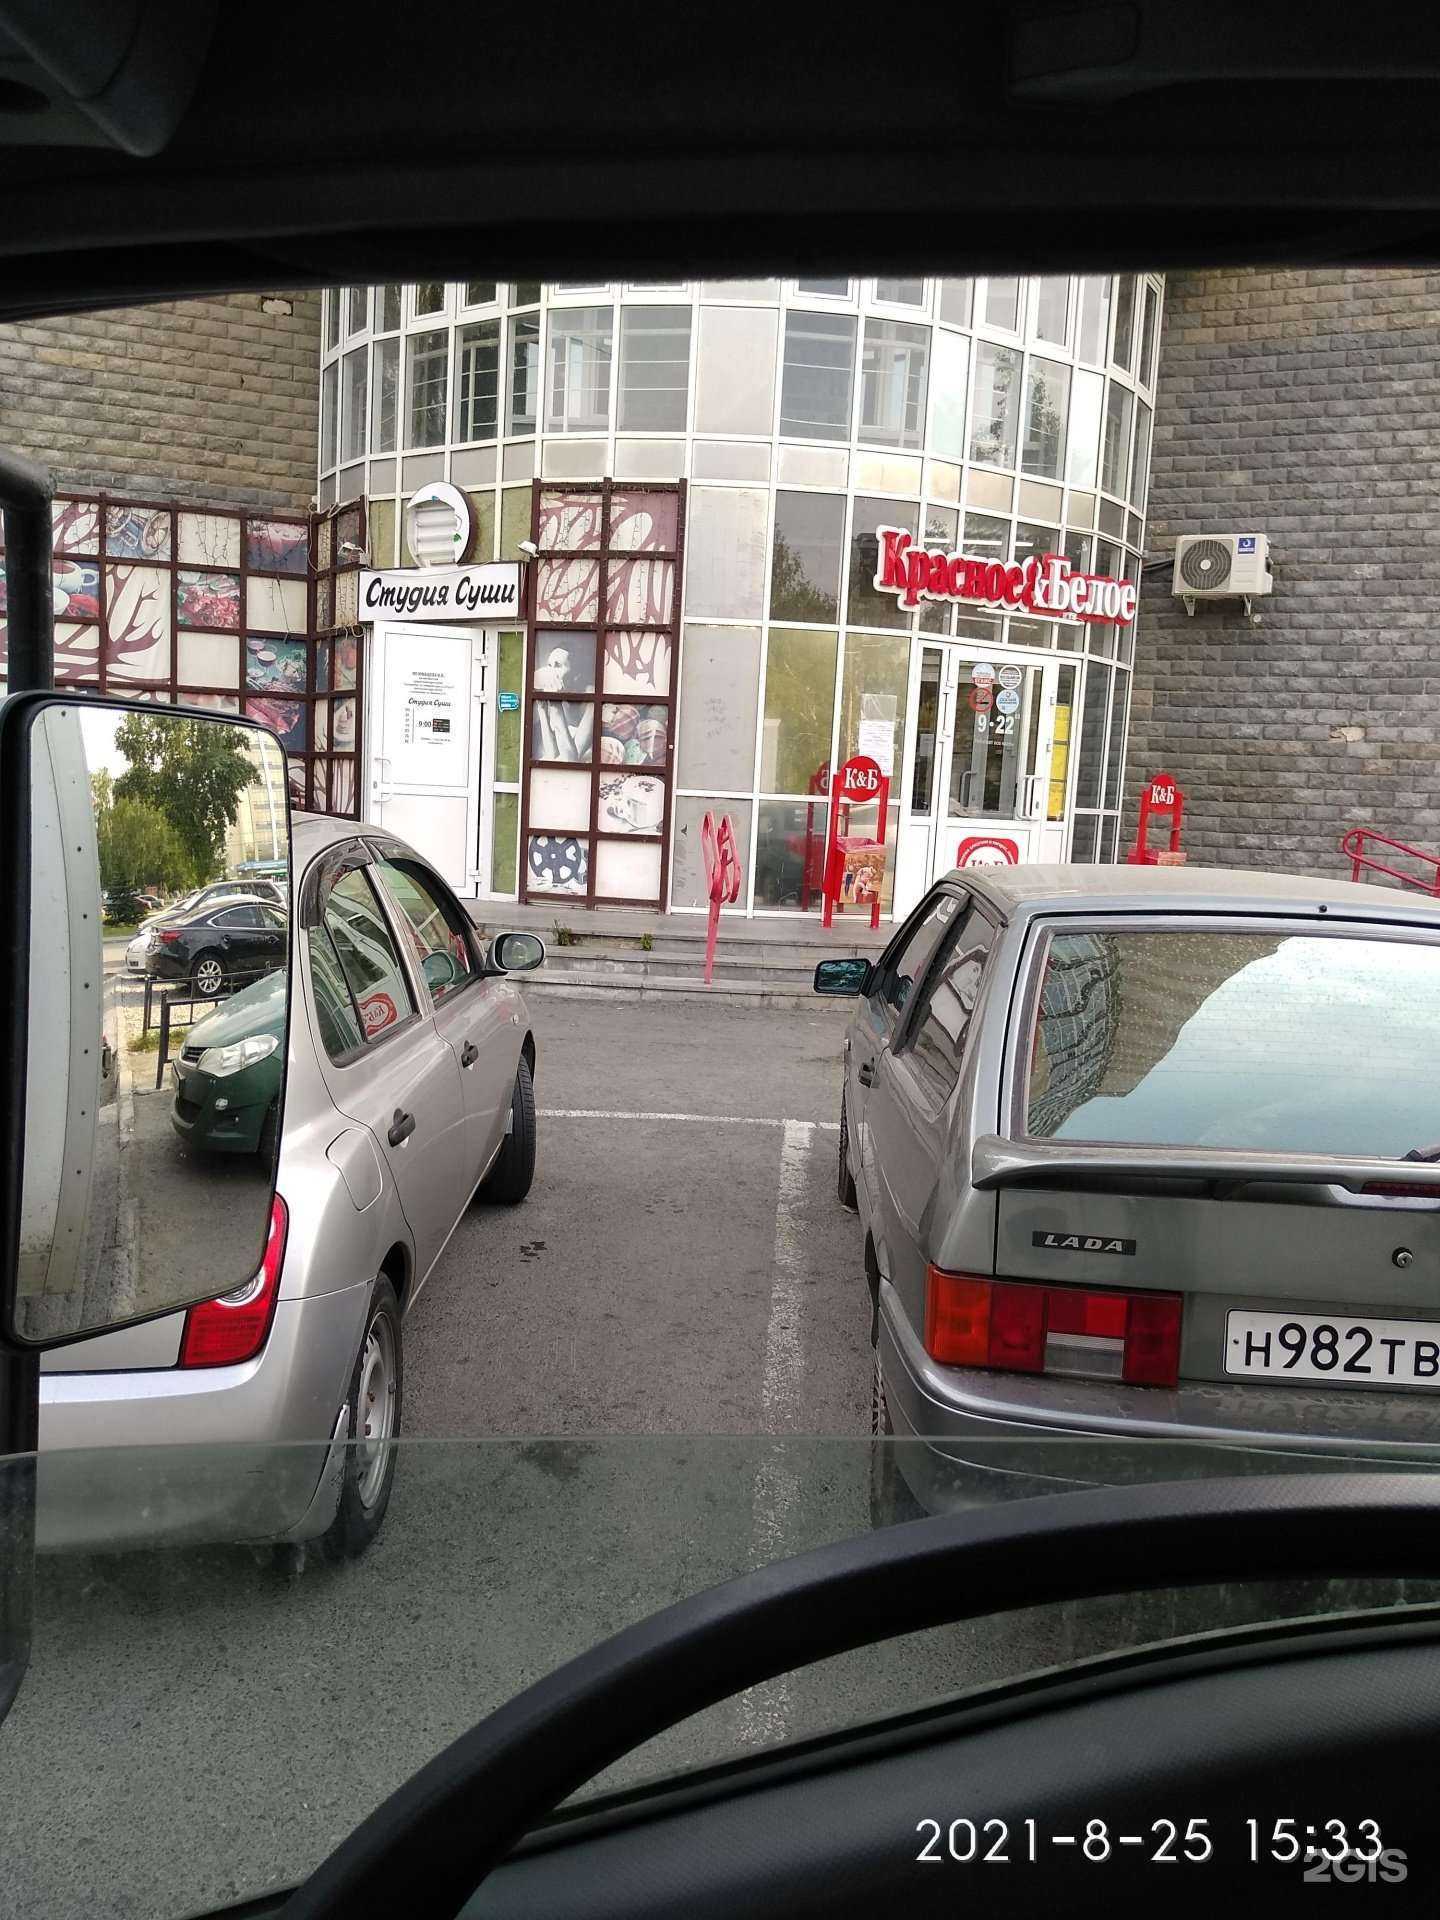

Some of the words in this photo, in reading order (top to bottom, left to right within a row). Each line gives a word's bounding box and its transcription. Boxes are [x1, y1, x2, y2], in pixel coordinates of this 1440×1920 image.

[365, 577, 450, 613] Студия
[455, 576, 516, 611] Суши
[844, 767, 878, 791] К&Б
[1150, 784, 1175, 805] К&Б
[1044, 1233, 1124, 1253] LADA
[1244, 1322, 1440, 1378] Н982ТВ
